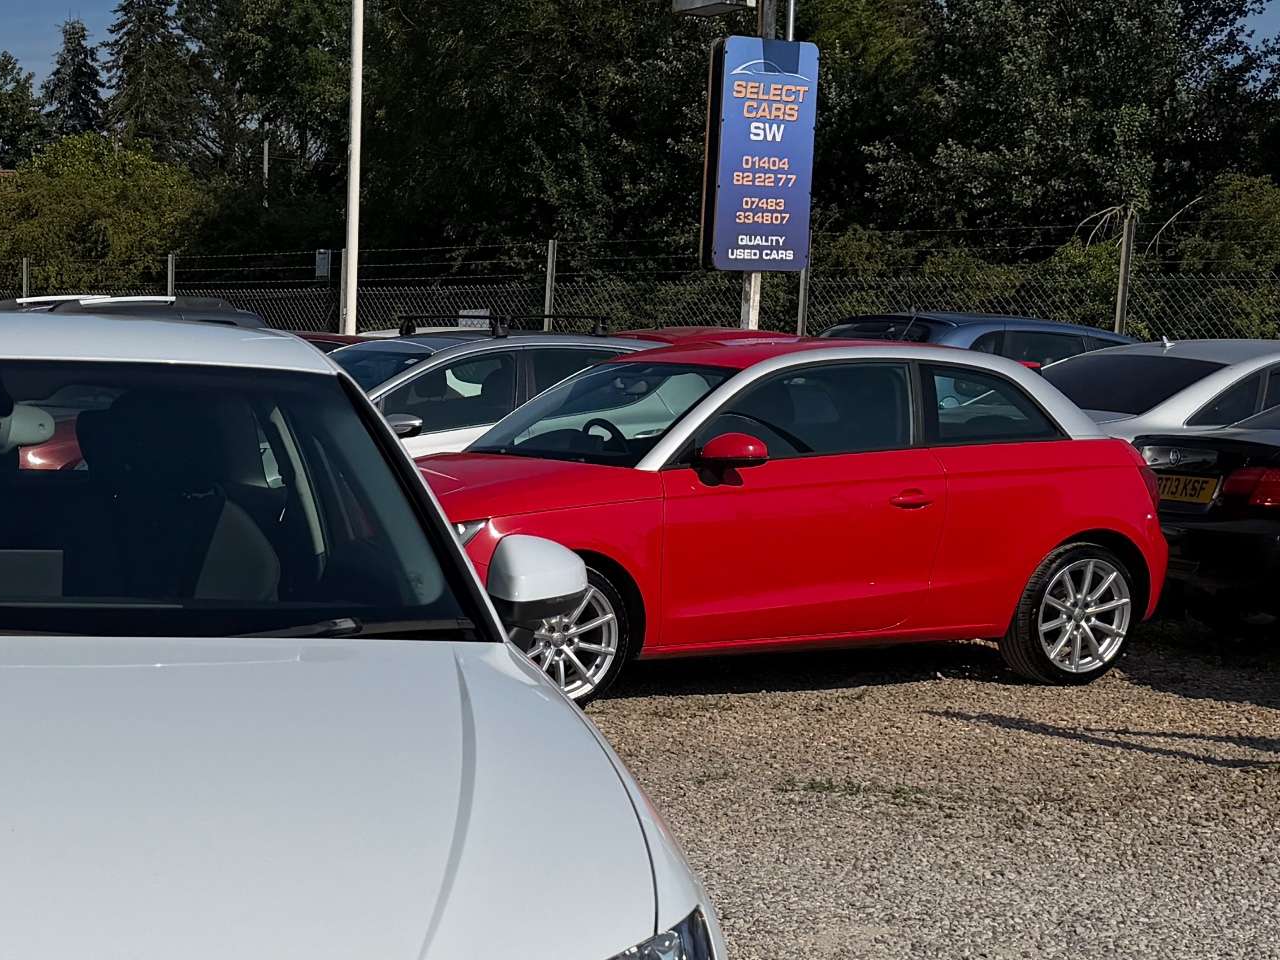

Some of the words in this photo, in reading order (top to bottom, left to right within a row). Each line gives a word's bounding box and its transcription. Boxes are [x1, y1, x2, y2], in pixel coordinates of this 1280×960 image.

[732, 80, 809, 103] SELECT
[743, 101, 799, 121] CARS
[750, 122, 785, 141] SW
[742, 155, 789, 170] 01404
[742, 197, 785, 210] 07483
[735, 211, 790, 225] 334807
[738, 234, 786, 246] QUALITY
[728, 249, 760, 259] USED
[762, 249, 794, 260] CARS
